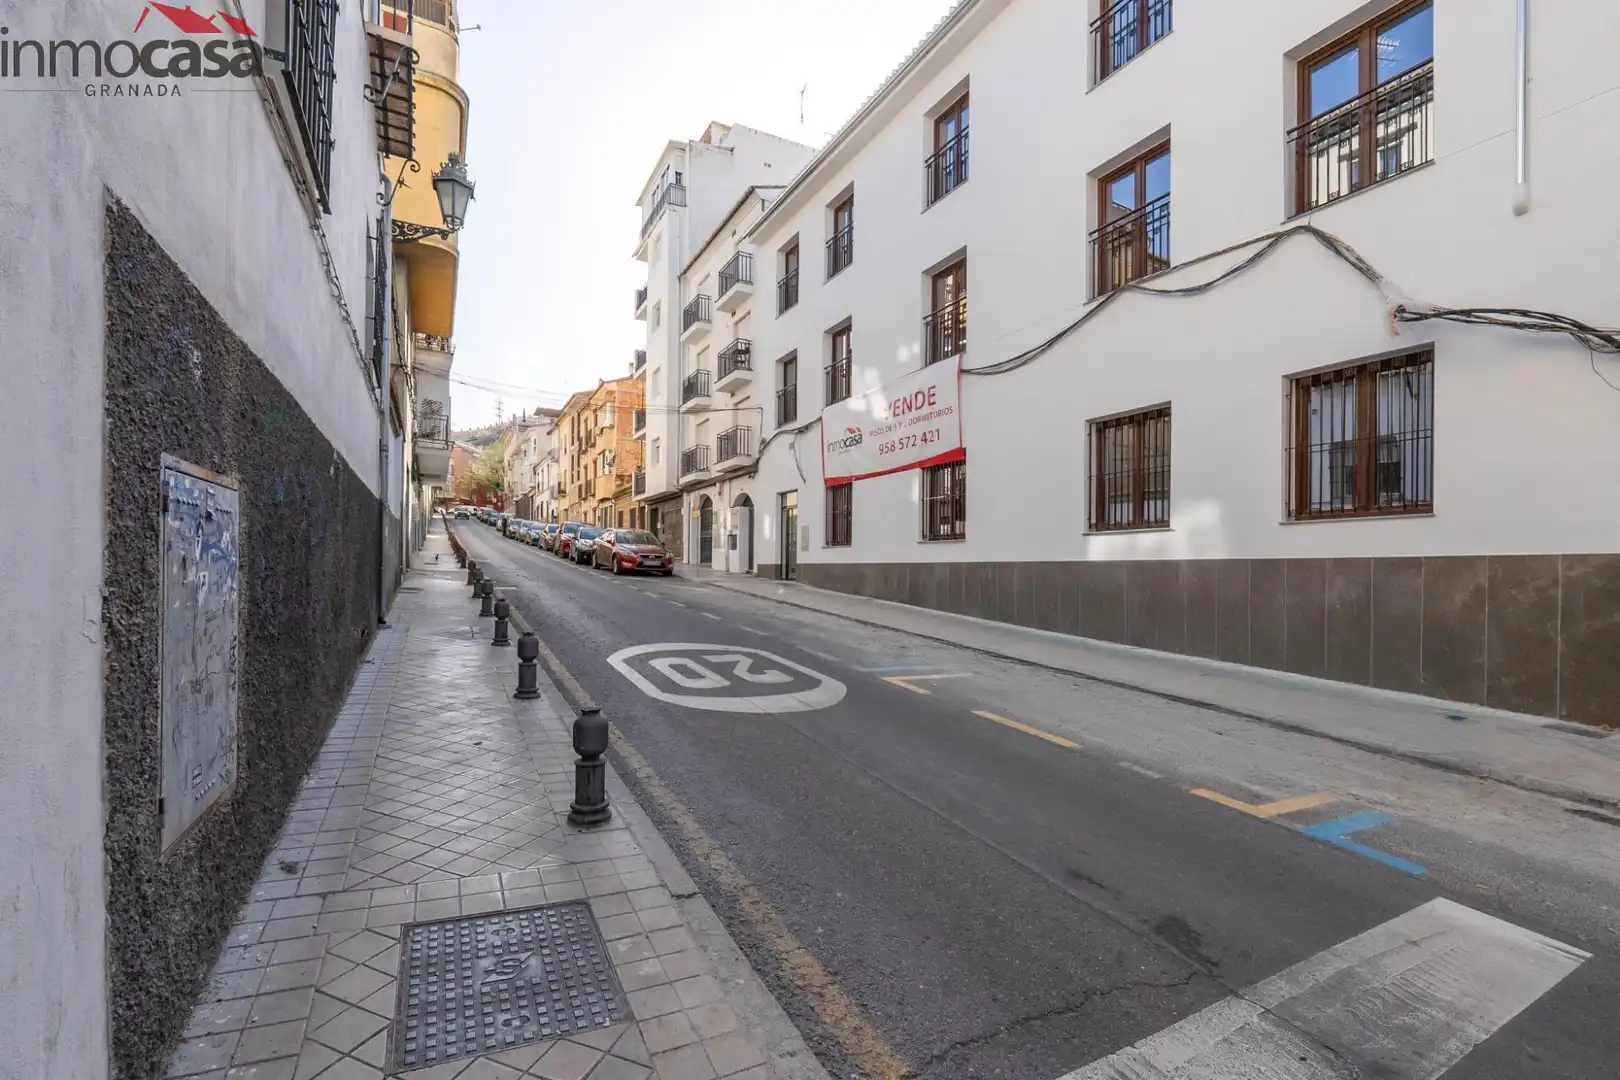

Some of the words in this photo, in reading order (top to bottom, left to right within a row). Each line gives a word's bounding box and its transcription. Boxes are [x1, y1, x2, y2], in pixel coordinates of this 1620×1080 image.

[878, 440, 896, 456] 958
[898, 434, 917, 451] 572
[920, 428, 941, 445] 421
[648, 654, 795, 689] 20
